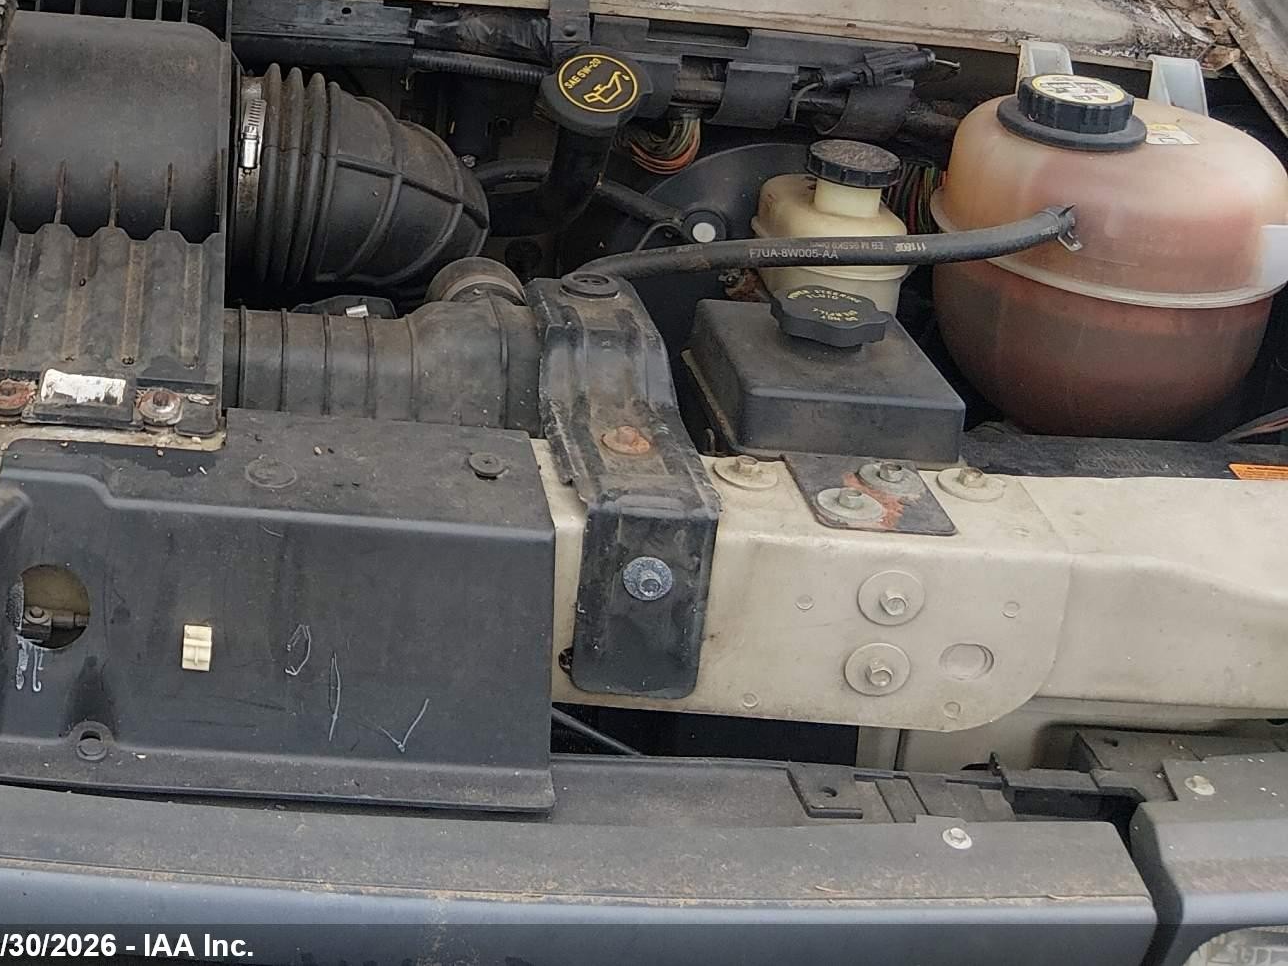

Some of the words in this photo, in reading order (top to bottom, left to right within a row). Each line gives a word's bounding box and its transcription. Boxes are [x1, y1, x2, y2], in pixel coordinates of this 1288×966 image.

[564, 75, 580, 89] SAE
[580, 58, 601, 78] 5W-20
[749, 248, 838, 259] F7UA-8W005-AA
